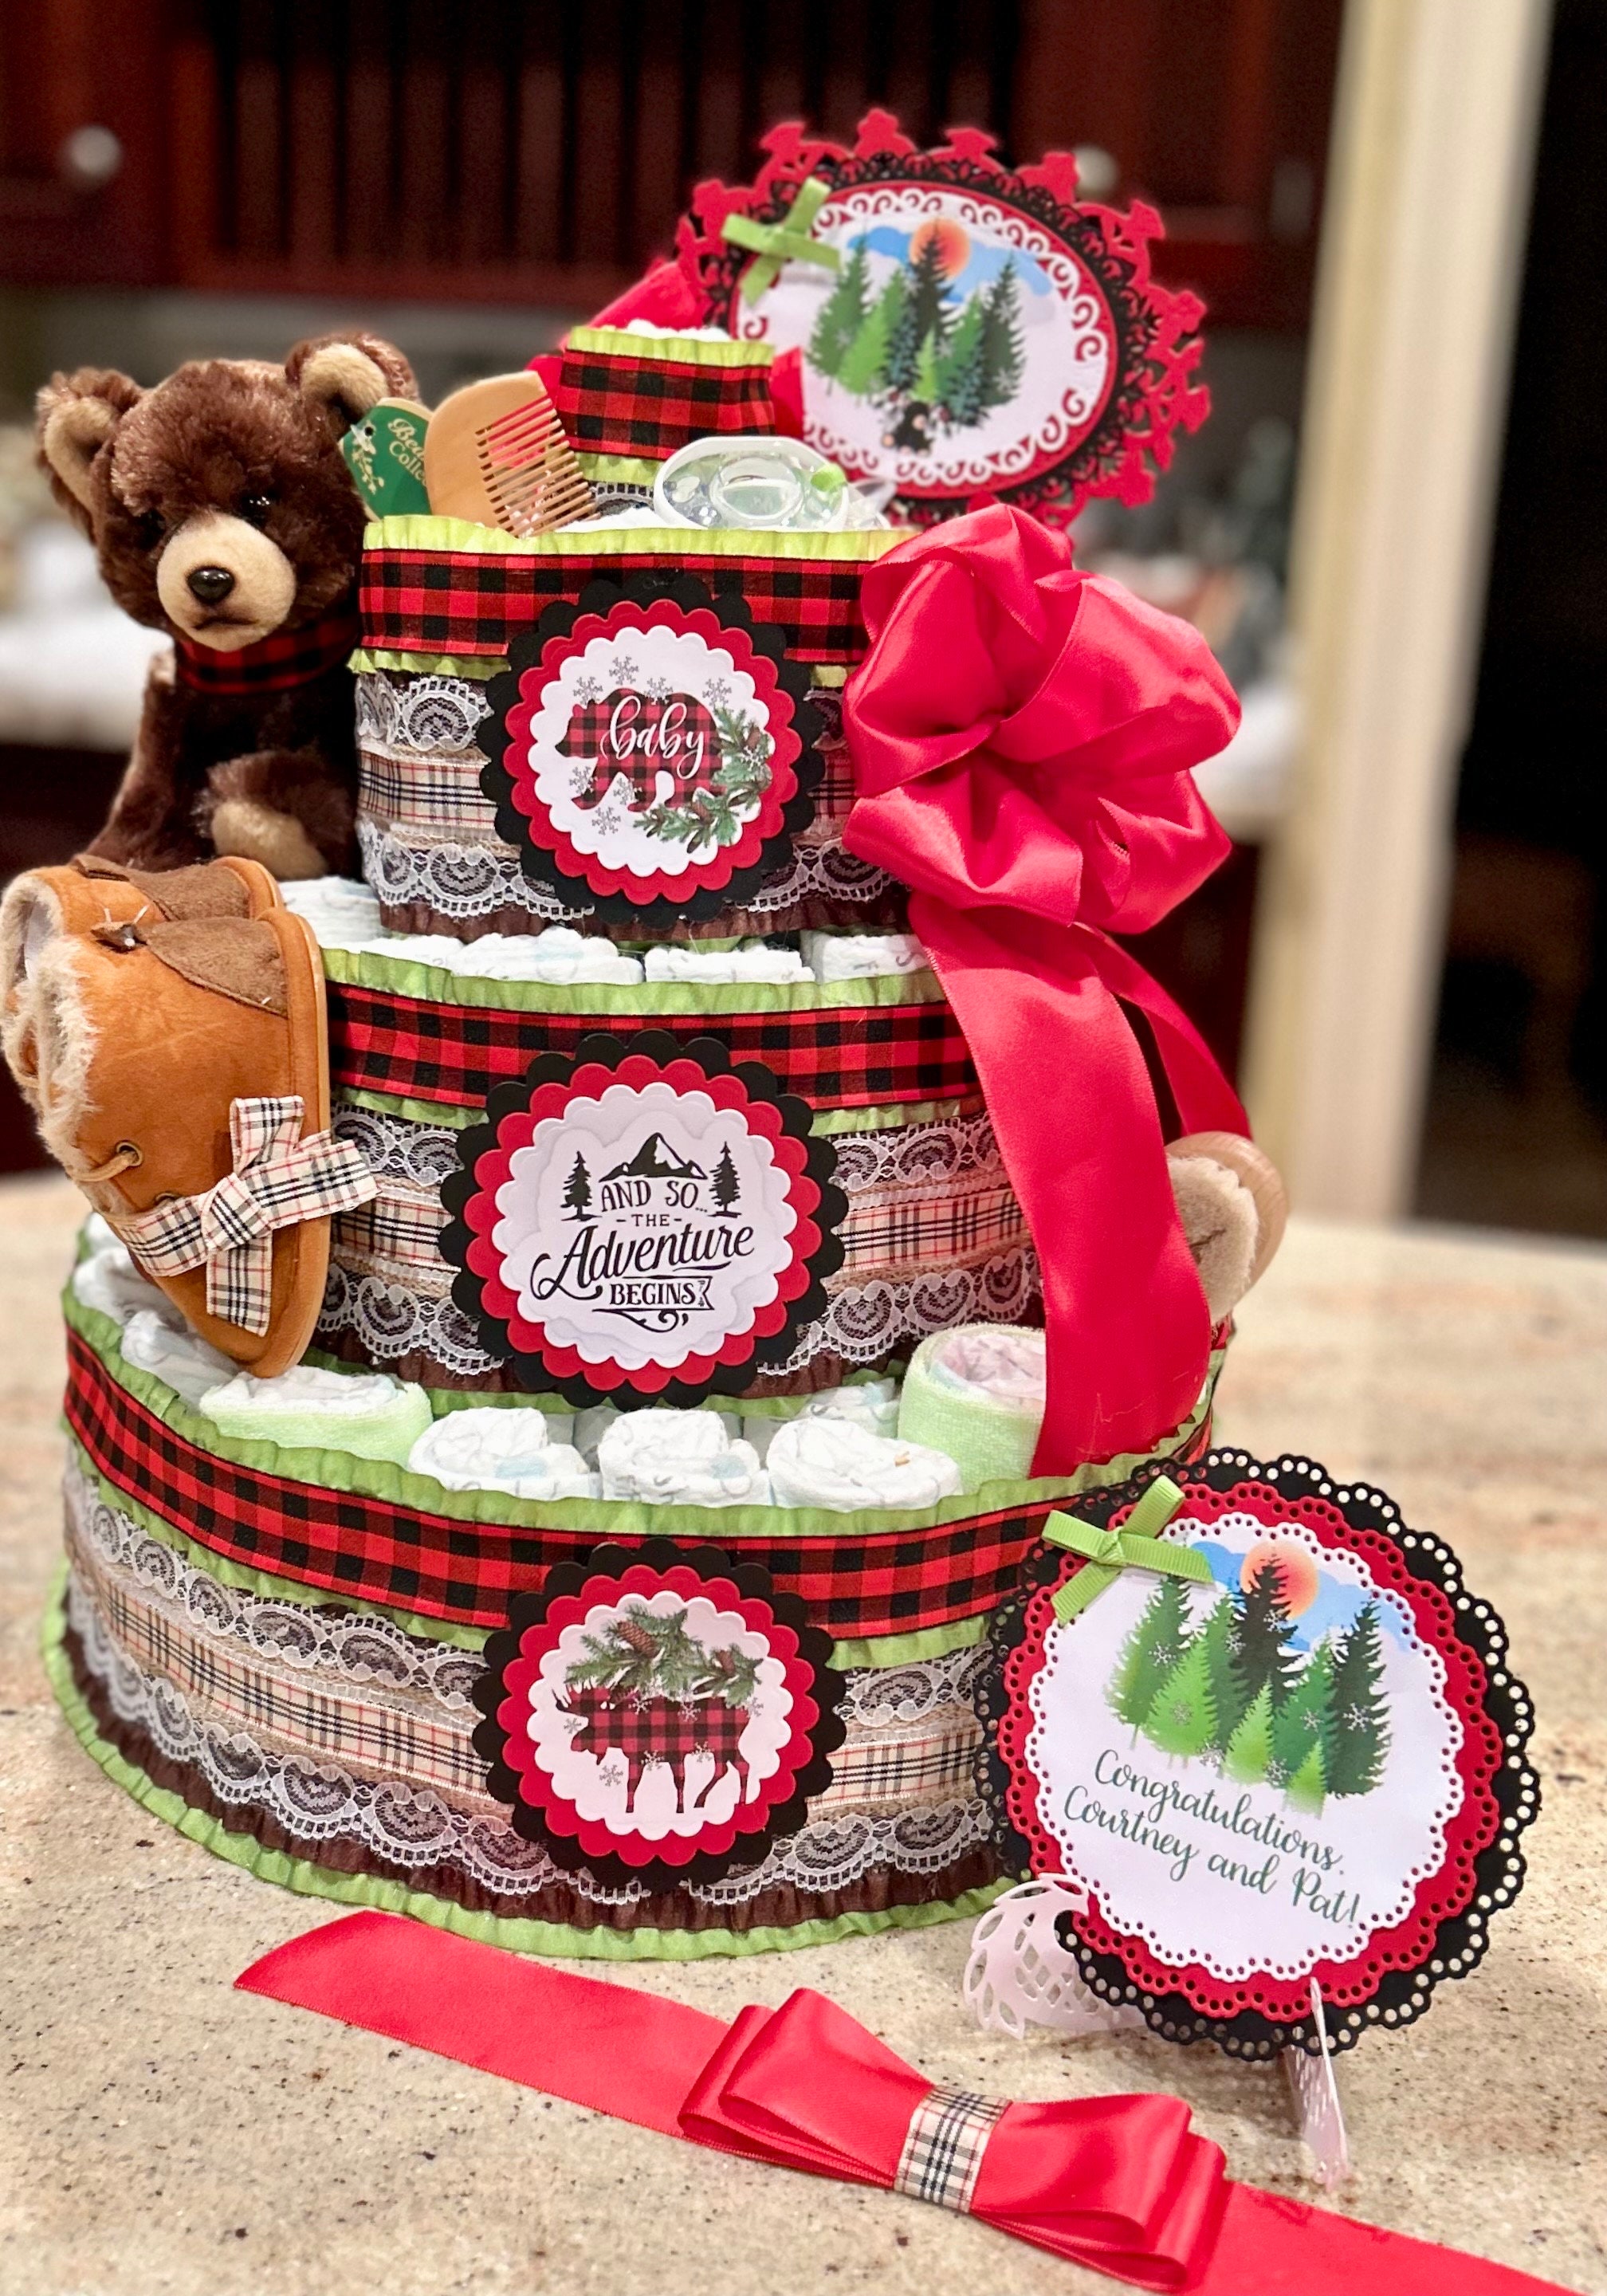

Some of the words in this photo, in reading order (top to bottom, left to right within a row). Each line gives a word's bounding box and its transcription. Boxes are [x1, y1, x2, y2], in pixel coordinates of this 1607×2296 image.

[387, 418, 425, 461] Bea
[600, 695, 704, 780] baby
[602, 1180, 651, 1212] AND
[530, 1223, 755, 1300] Adventure
[610, 1283, 696, 1305] BEGINS
[1064, 1785, 1199, 1881] Courtney
[1208, 1854, 1280, 1893] and
[1292, 1868, 1361, 1928] Pat!
